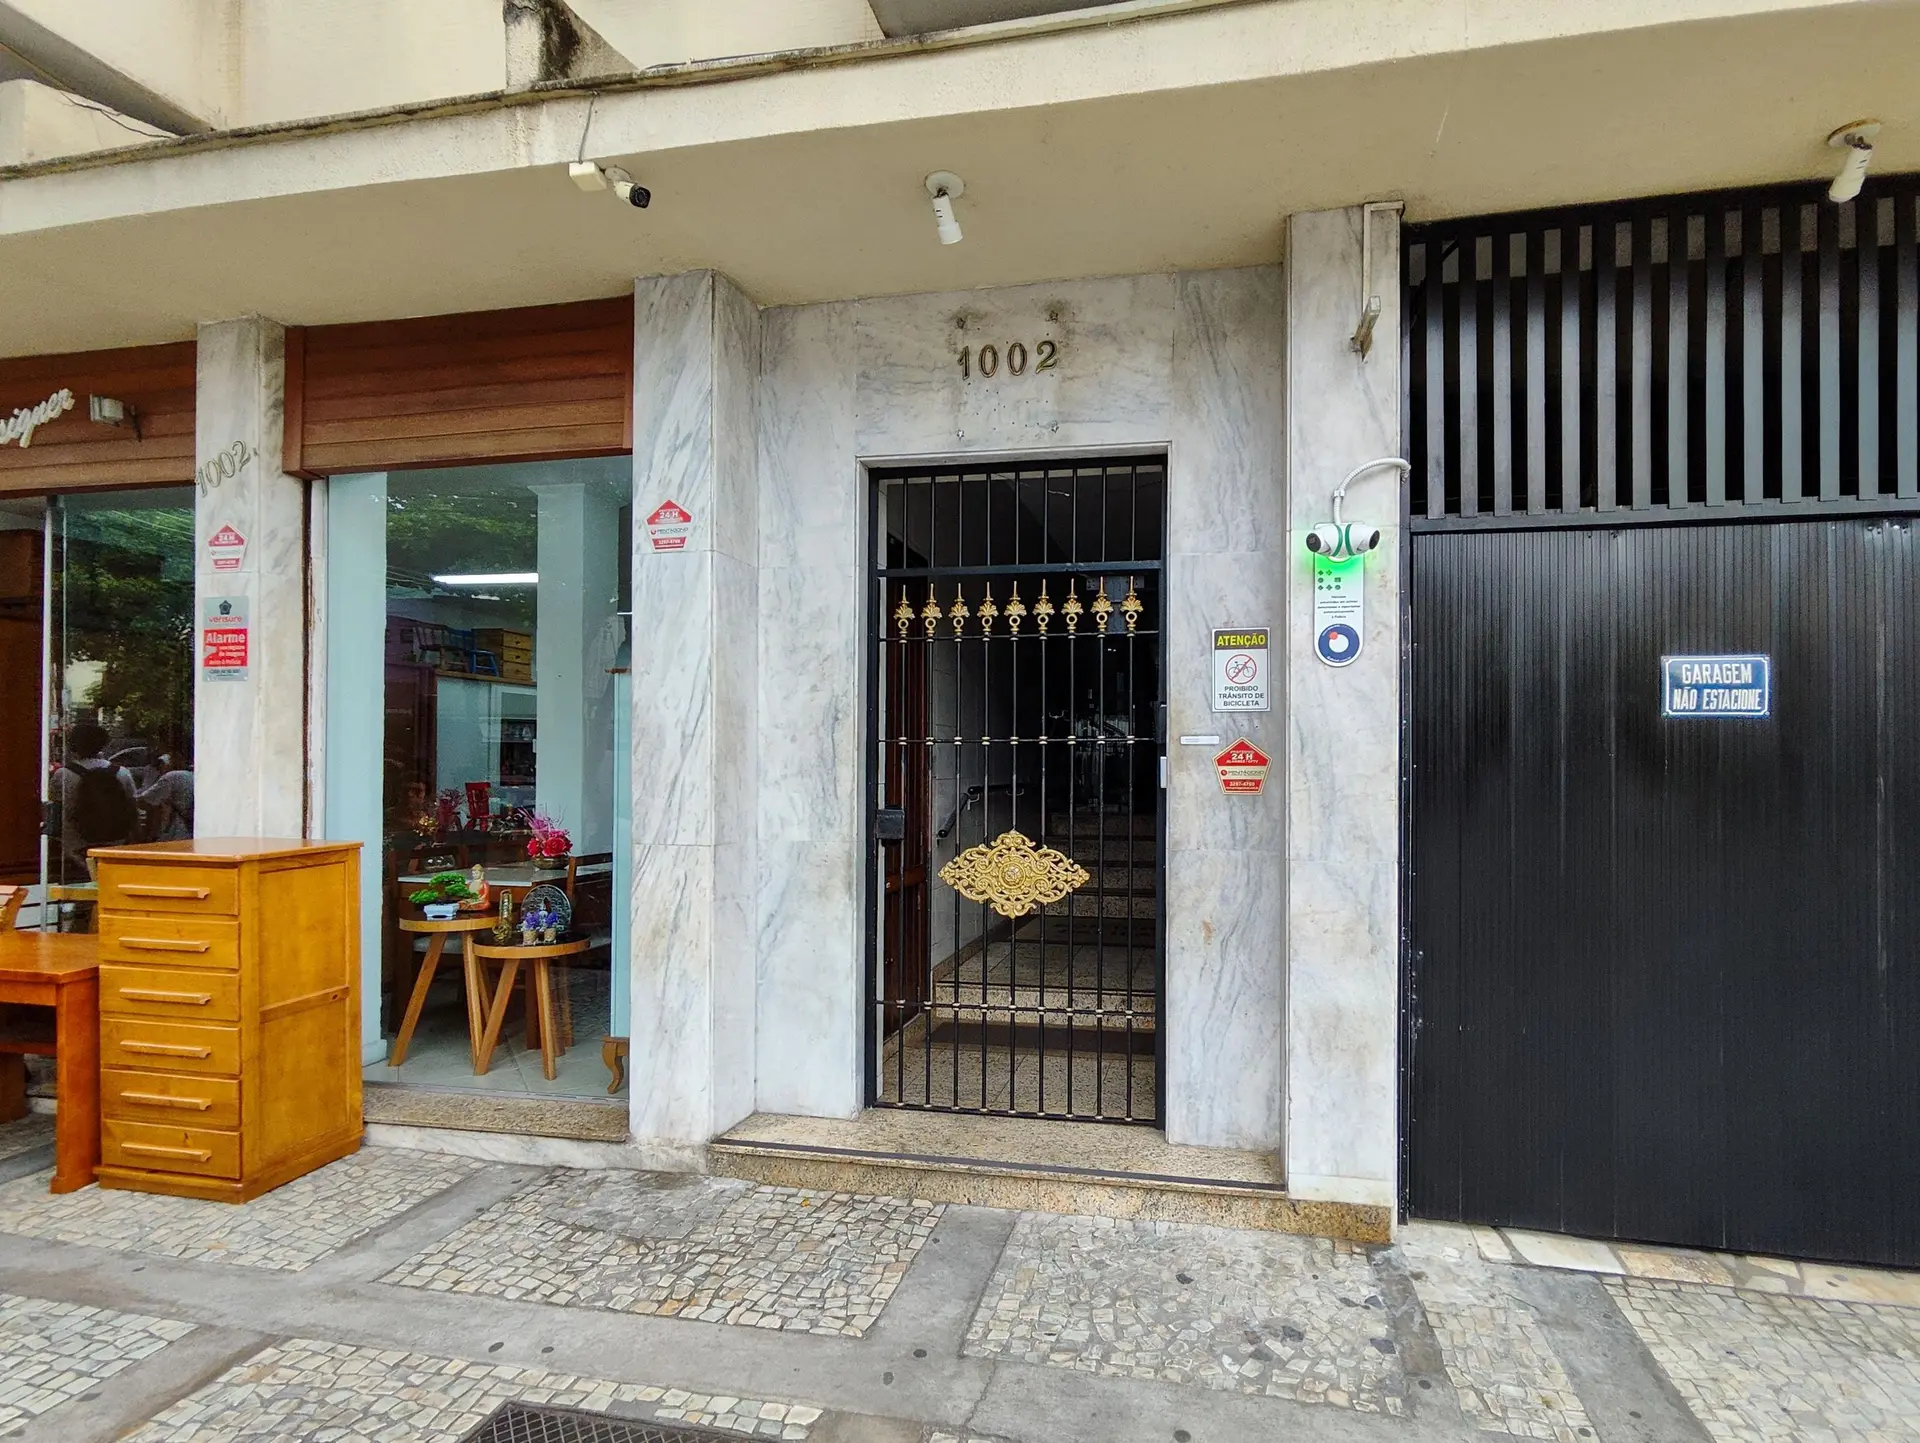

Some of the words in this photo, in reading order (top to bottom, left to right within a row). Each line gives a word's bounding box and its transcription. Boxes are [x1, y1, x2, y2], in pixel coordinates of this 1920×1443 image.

[957, 340, 1059, 380] 1002
[196, 440, 252, 498] 1002
[660, 511, 671, 519] 24
[206, 632, 246, 643] Alarme
[1217, 632, 1266, 648] ATENÇÃO
[1682, 664, 1752, 684] GARAGEM
[1673, 687, 1698, 710] NÃO
[1703, 688, 1763, 710] ESTACIONE
